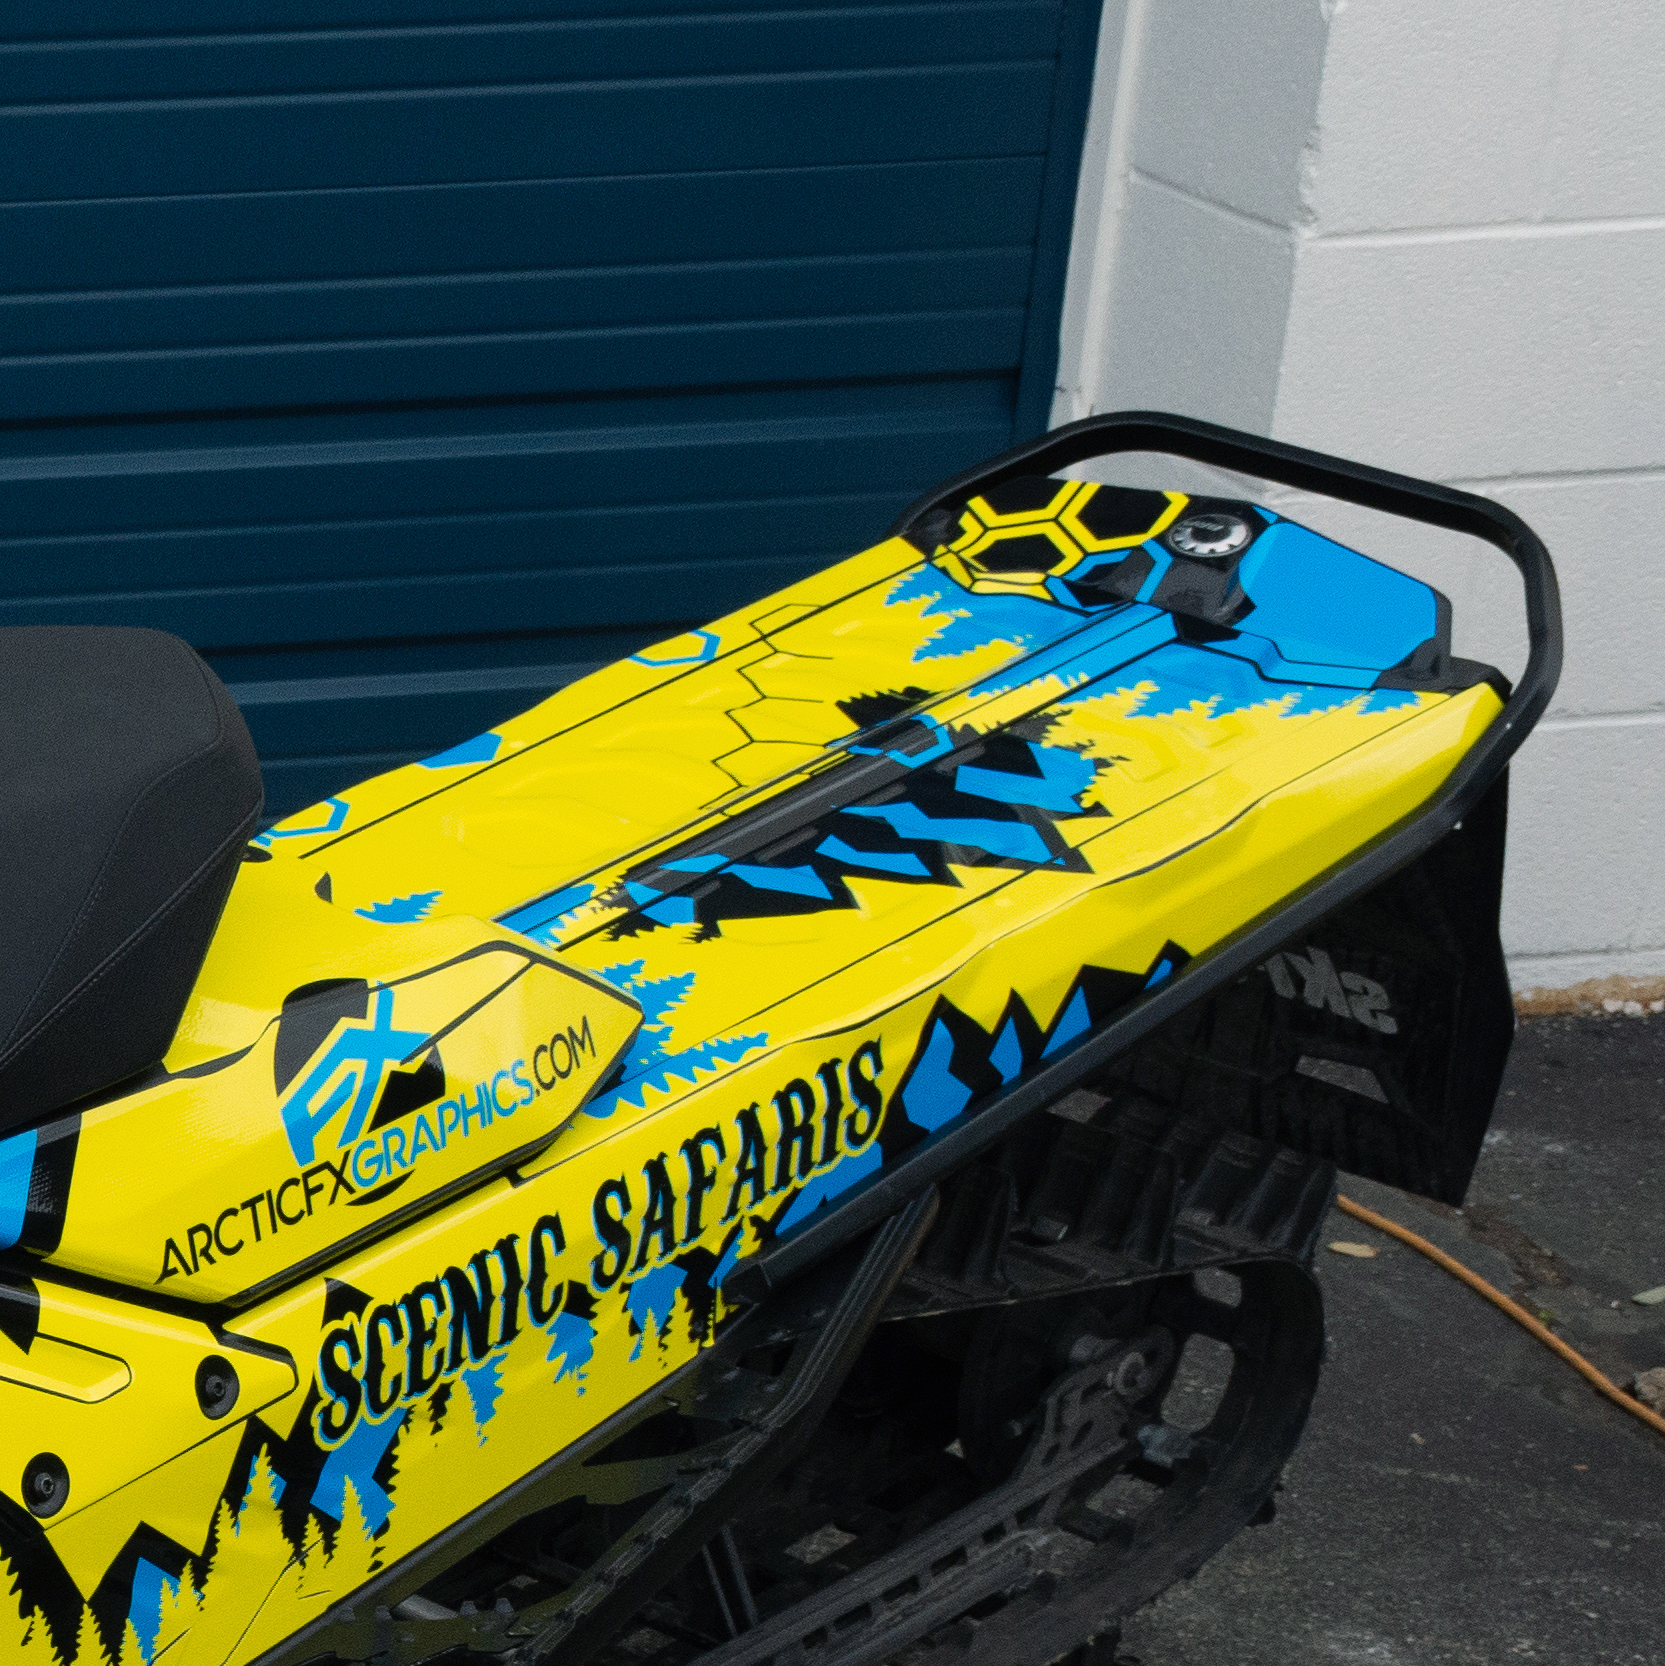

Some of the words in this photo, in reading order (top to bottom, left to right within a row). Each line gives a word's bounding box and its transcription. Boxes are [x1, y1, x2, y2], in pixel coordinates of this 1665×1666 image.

[153, 1016, 597, 1285] ARCTICFXGRAPHICS.COM
[317, 1211, 567, 1442] SCENIC
[591, 1039, 888, 1292] SAFARIS
